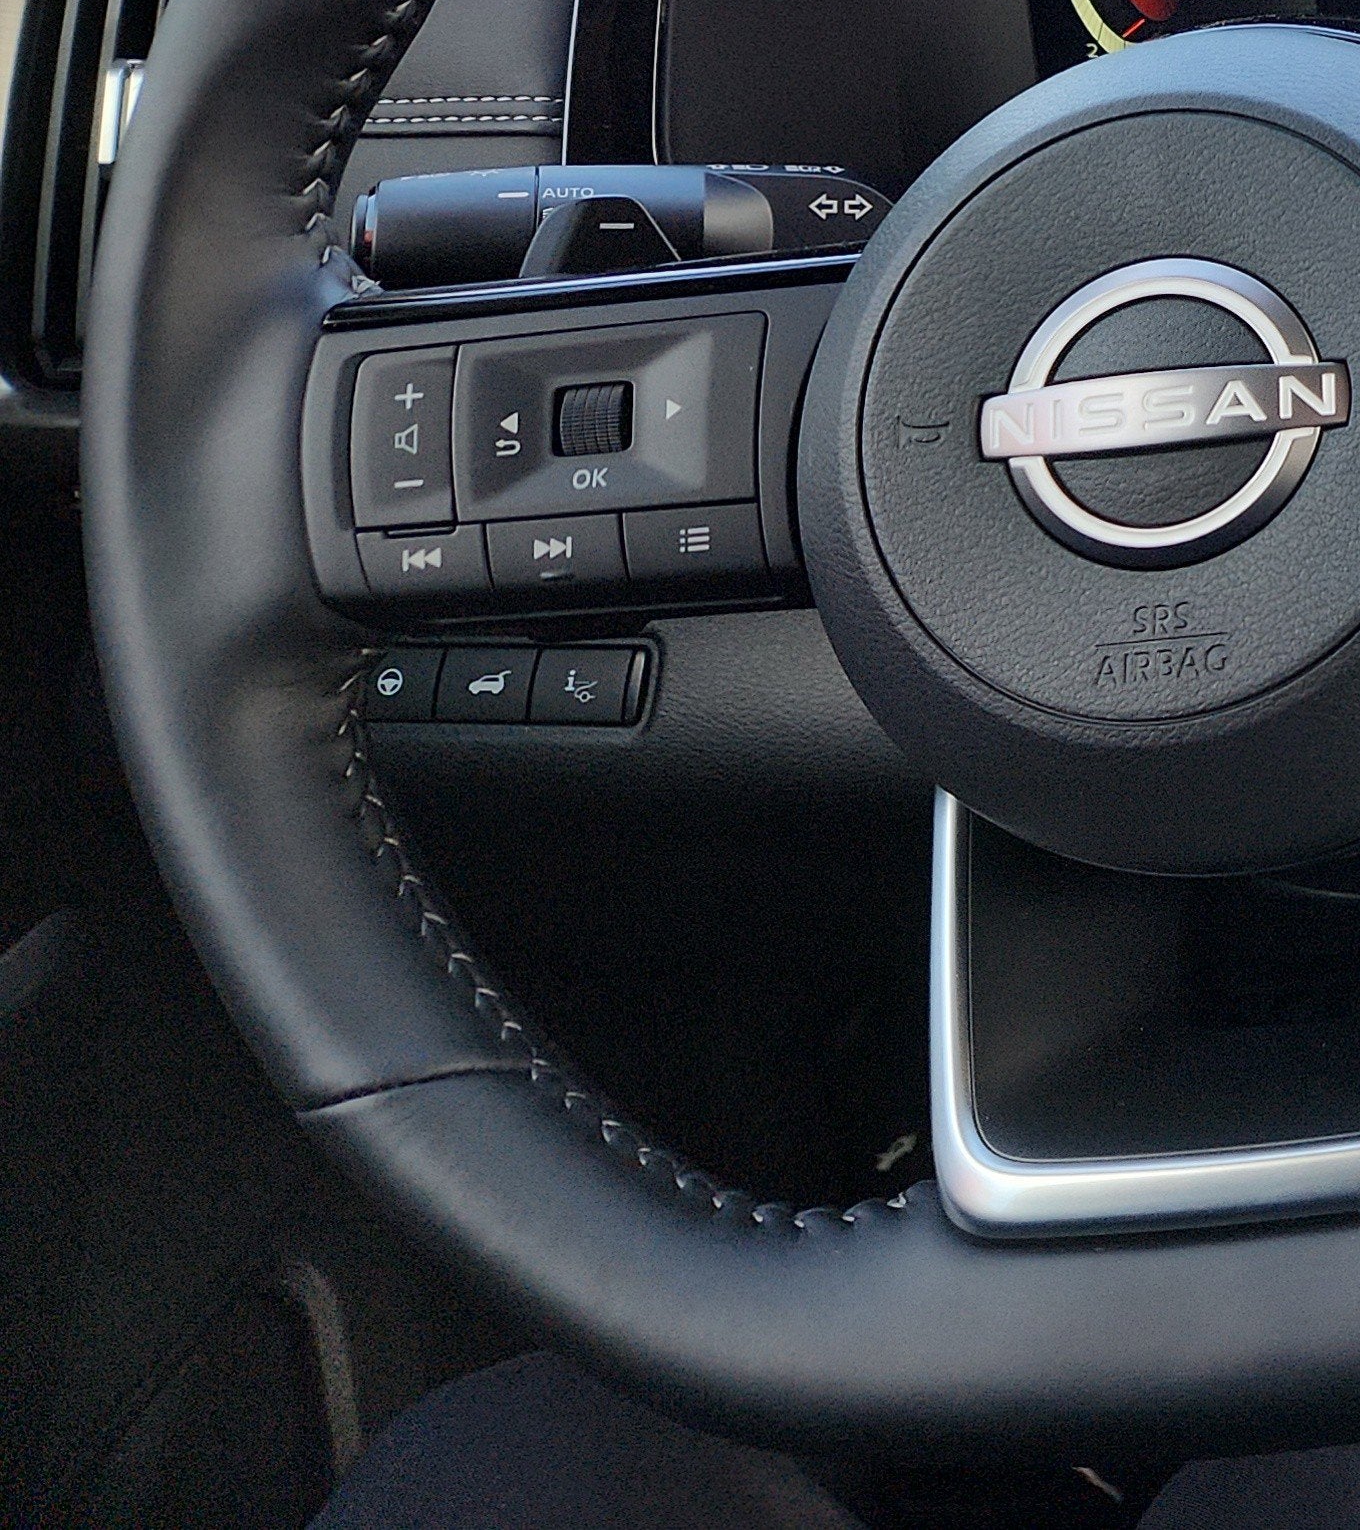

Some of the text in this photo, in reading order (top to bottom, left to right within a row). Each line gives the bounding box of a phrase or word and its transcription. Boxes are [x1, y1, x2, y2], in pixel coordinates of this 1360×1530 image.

[541, 187, 595, 200] AUTO
[987, 371, 1337, 450] NISSAN
[572, 467, 609, 490] OK
[1132, 601, 1191, 633] SRS
[1095, 643, 1229, 687] AIRBAG
